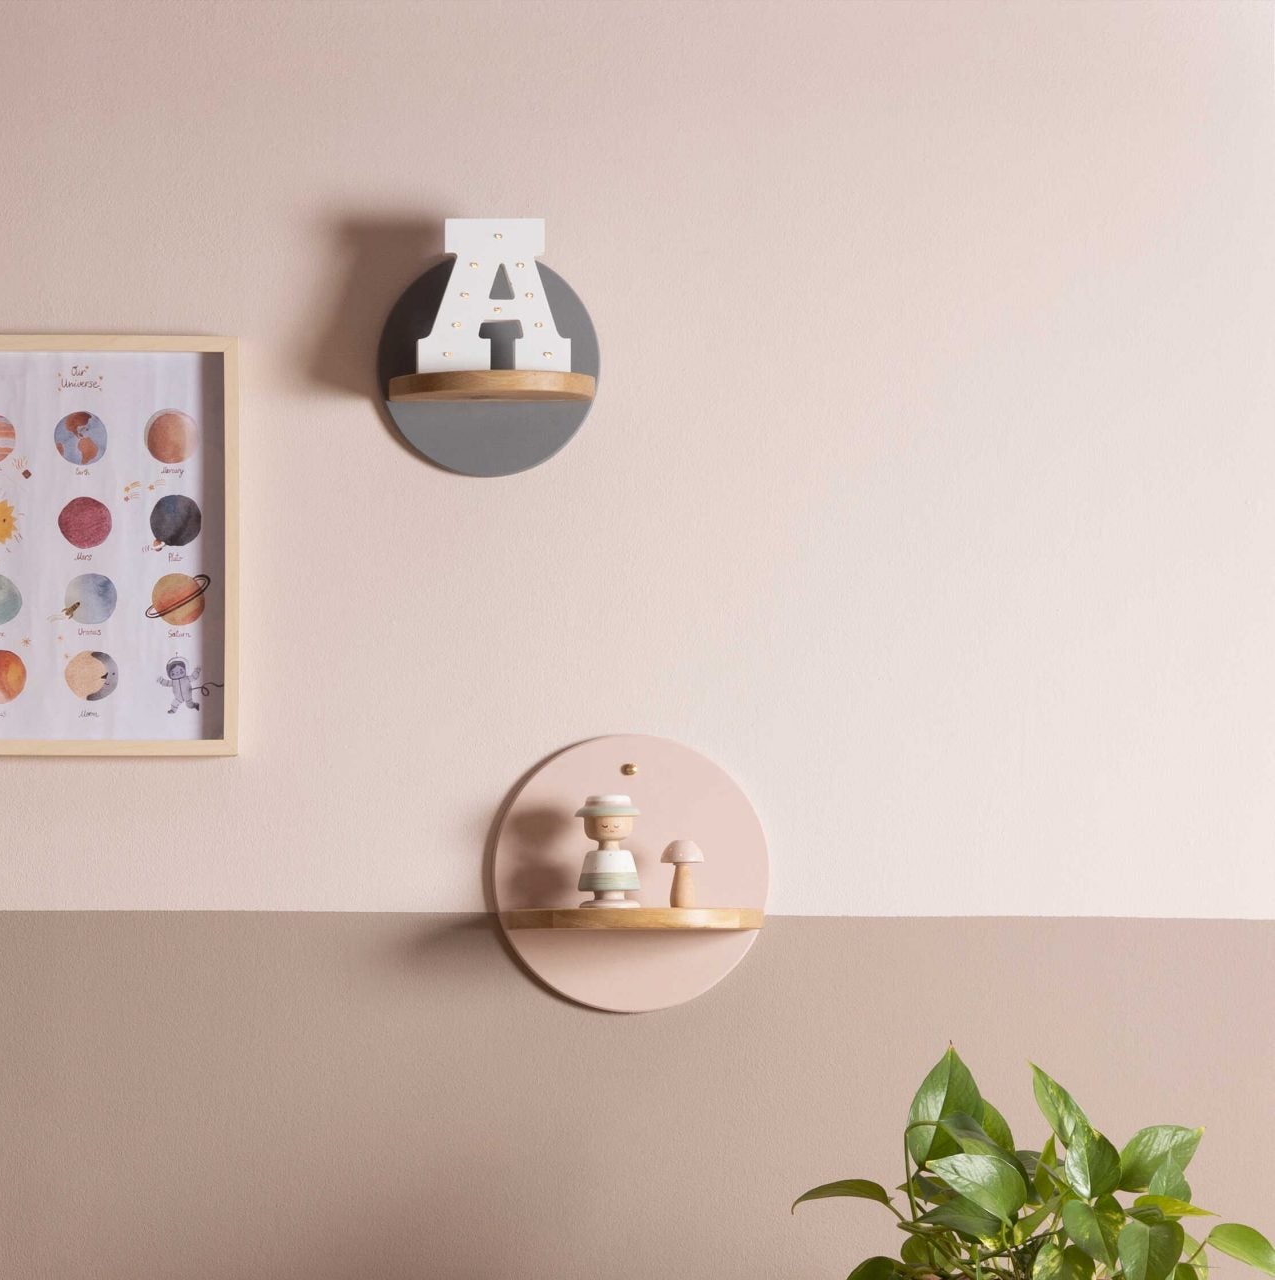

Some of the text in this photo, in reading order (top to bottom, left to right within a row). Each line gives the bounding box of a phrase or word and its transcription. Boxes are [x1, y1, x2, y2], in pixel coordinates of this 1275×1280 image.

[416, 218, 571, 373] A
[71, 364, 86, 376] Our
[61, 379, 100, 388] Universe
